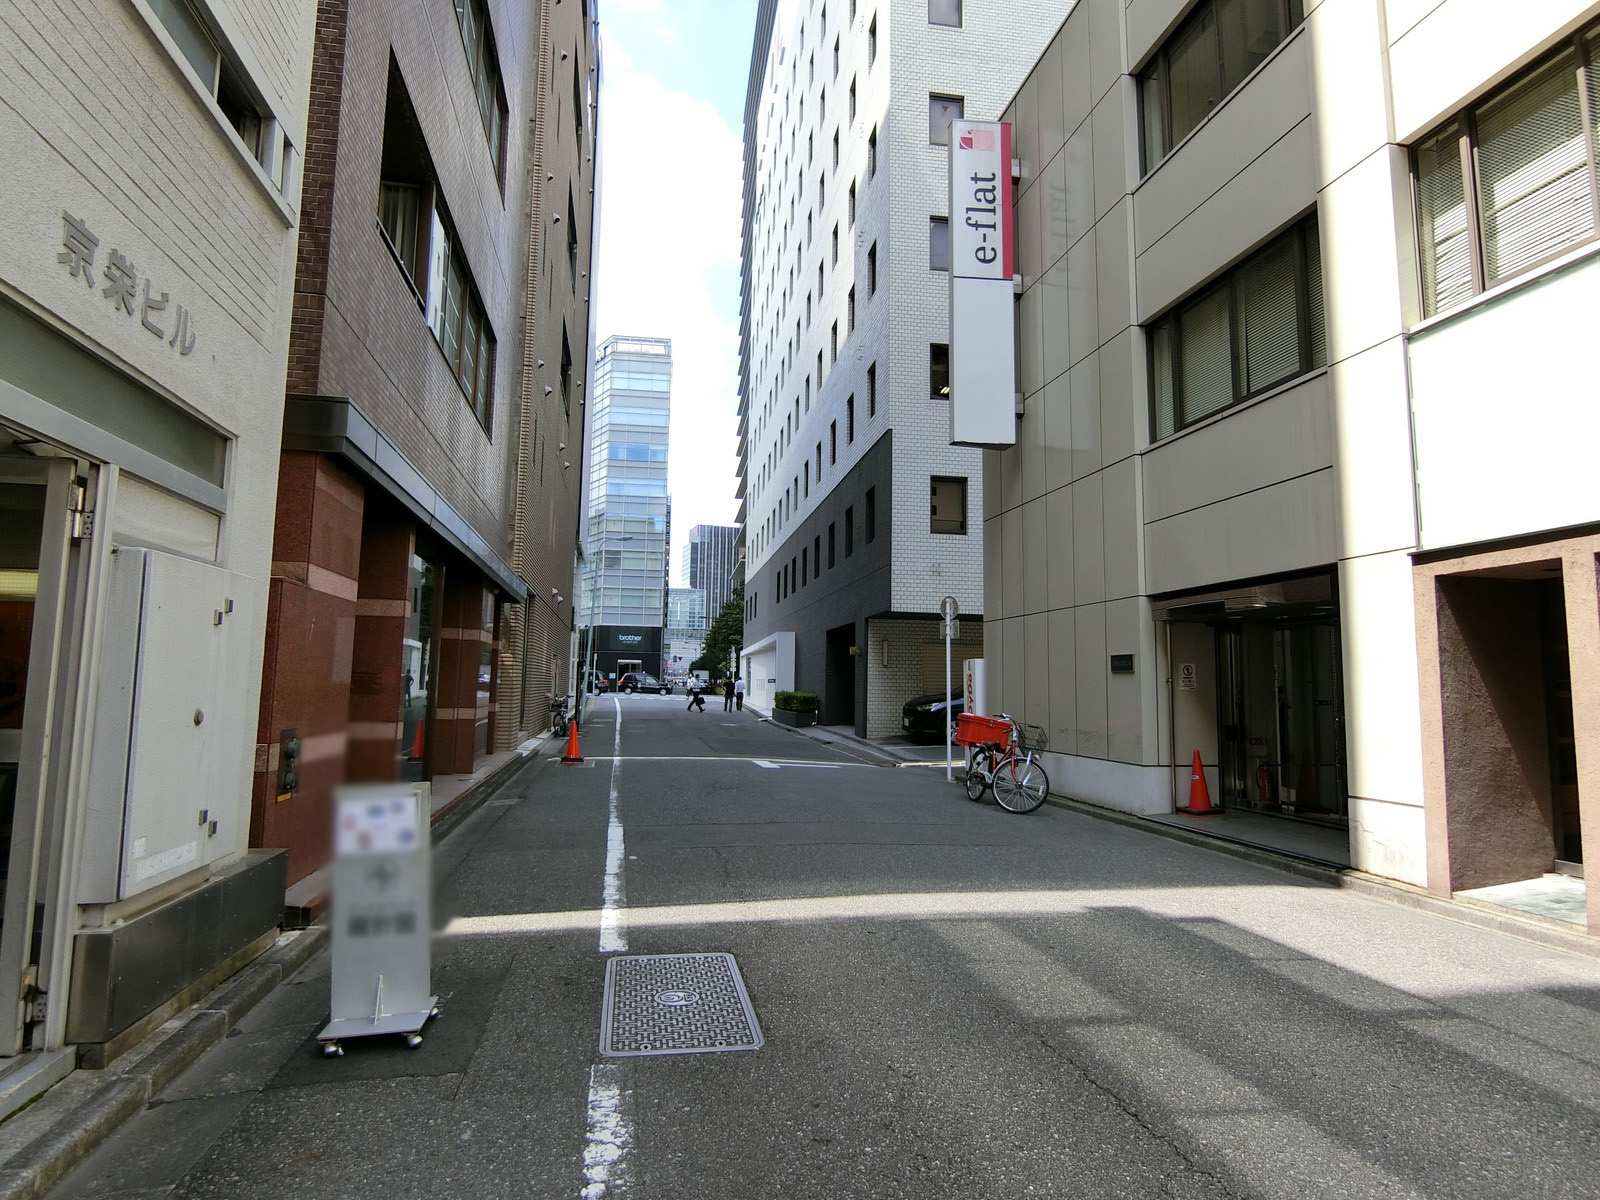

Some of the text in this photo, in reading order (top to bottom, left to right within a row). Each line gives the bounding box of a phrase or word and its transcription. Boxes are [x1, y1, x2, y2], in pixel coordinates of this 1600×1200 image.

[966, 172, 997, 264] e-flat
[58, 210, 196, 355] 京栄ビル
